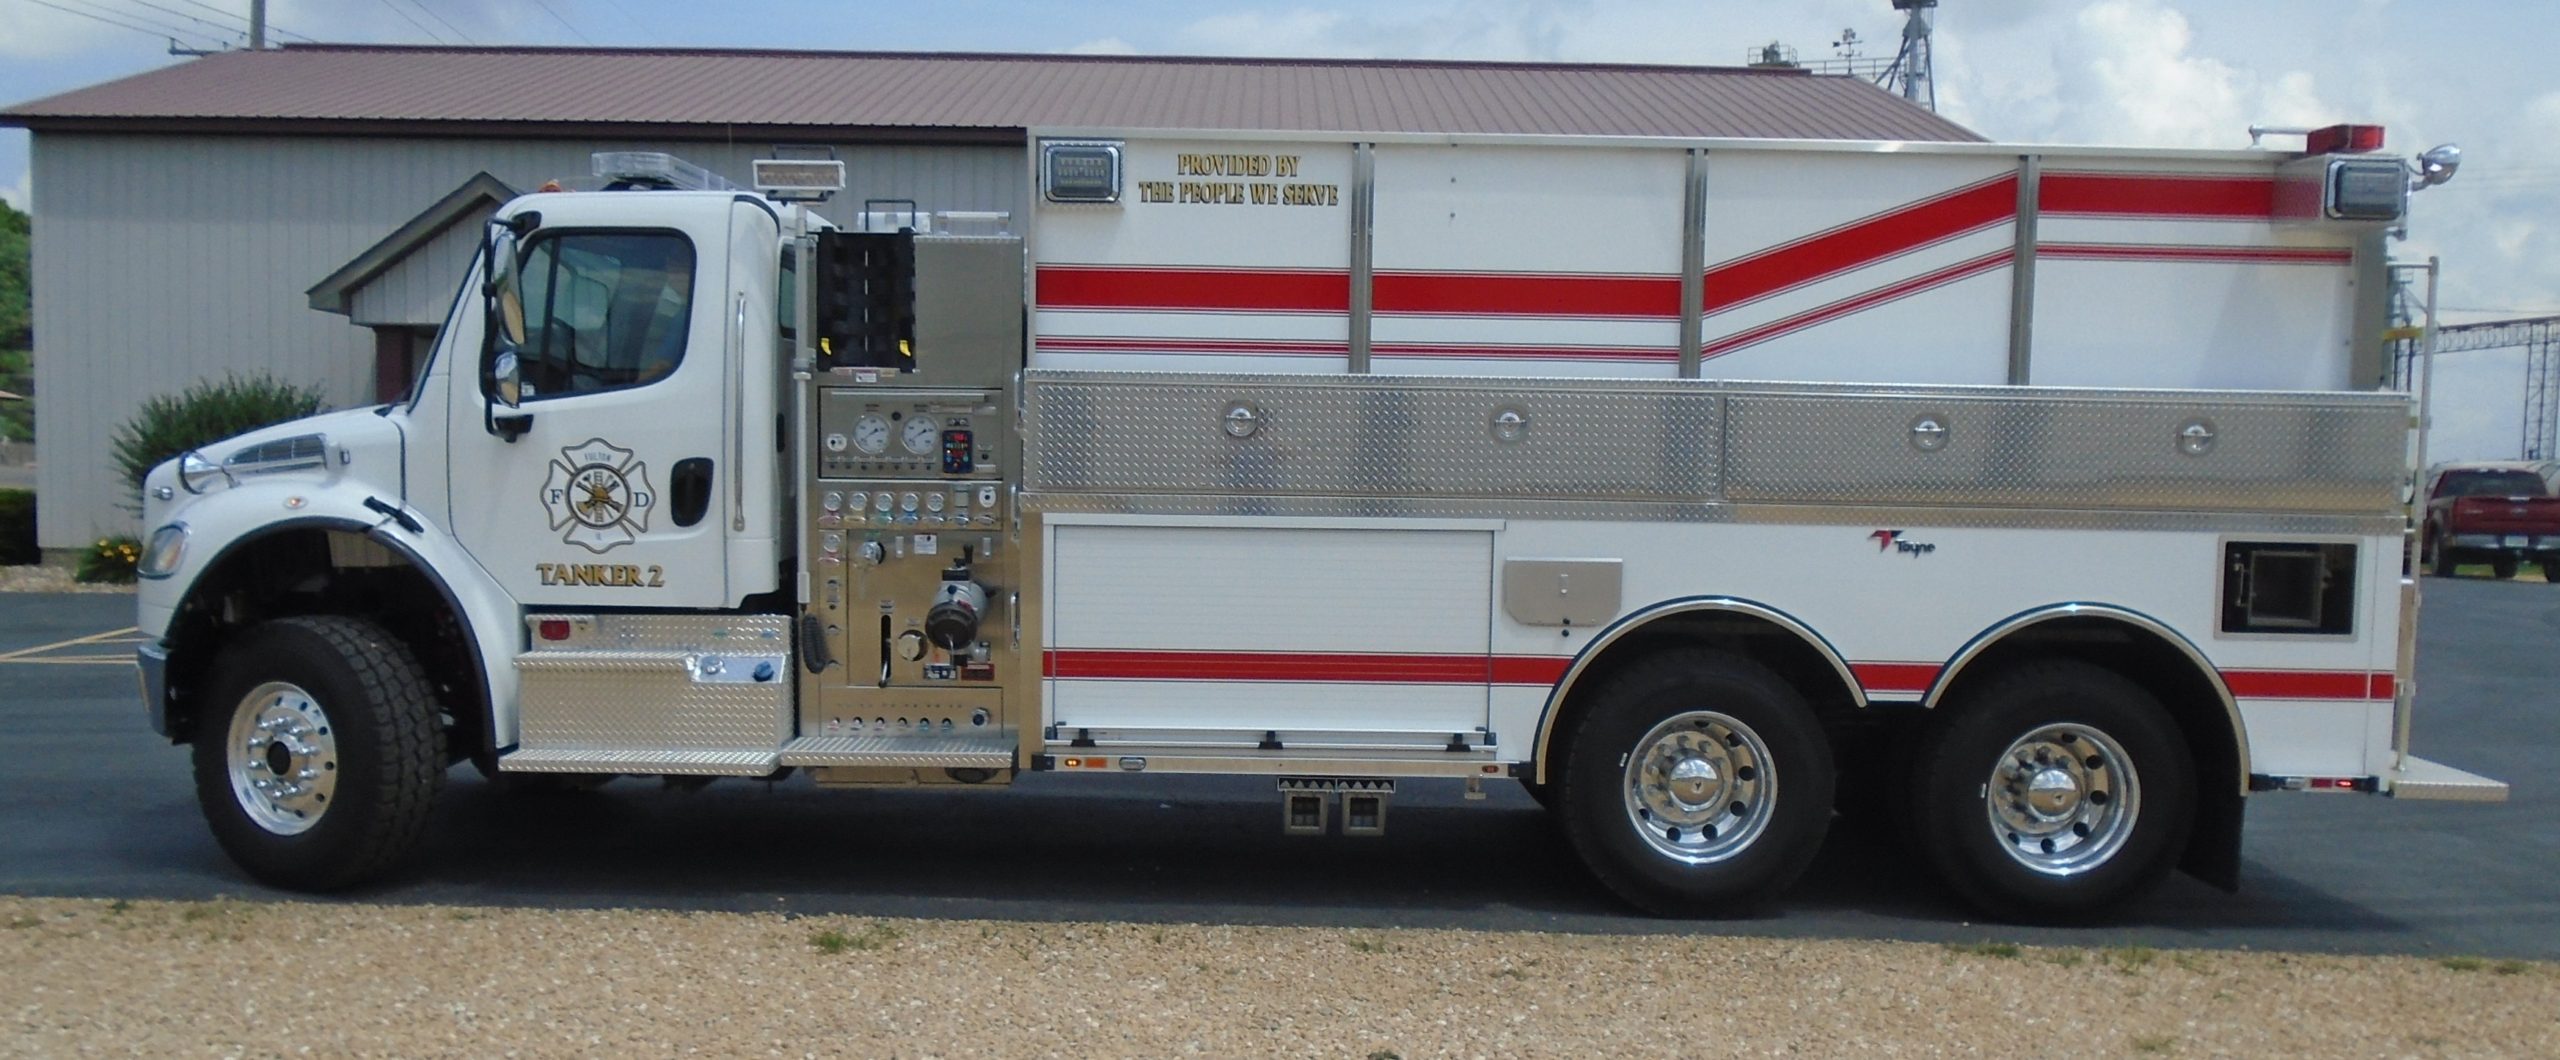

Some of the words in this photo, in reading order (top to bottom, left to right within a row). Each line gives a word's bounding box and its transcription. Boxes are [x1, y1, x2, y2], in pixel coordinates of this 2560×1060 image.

[1177, 153, 1271, 176] PROVIDED
[1276, 155, 1300, 177] BY
[1138, 181, 1174, 203] THE
[1179, 182, 1245, 204] PEOPLE
[1250, 183, 1278, 205] WE
[1282, 184, 1339, 206] SERVE
[550, 489, 563, 504] F
[633, 492, 649, 507] D
[536, 563, 645, 587] TANKER
[647, 565, 665, 587] 2
